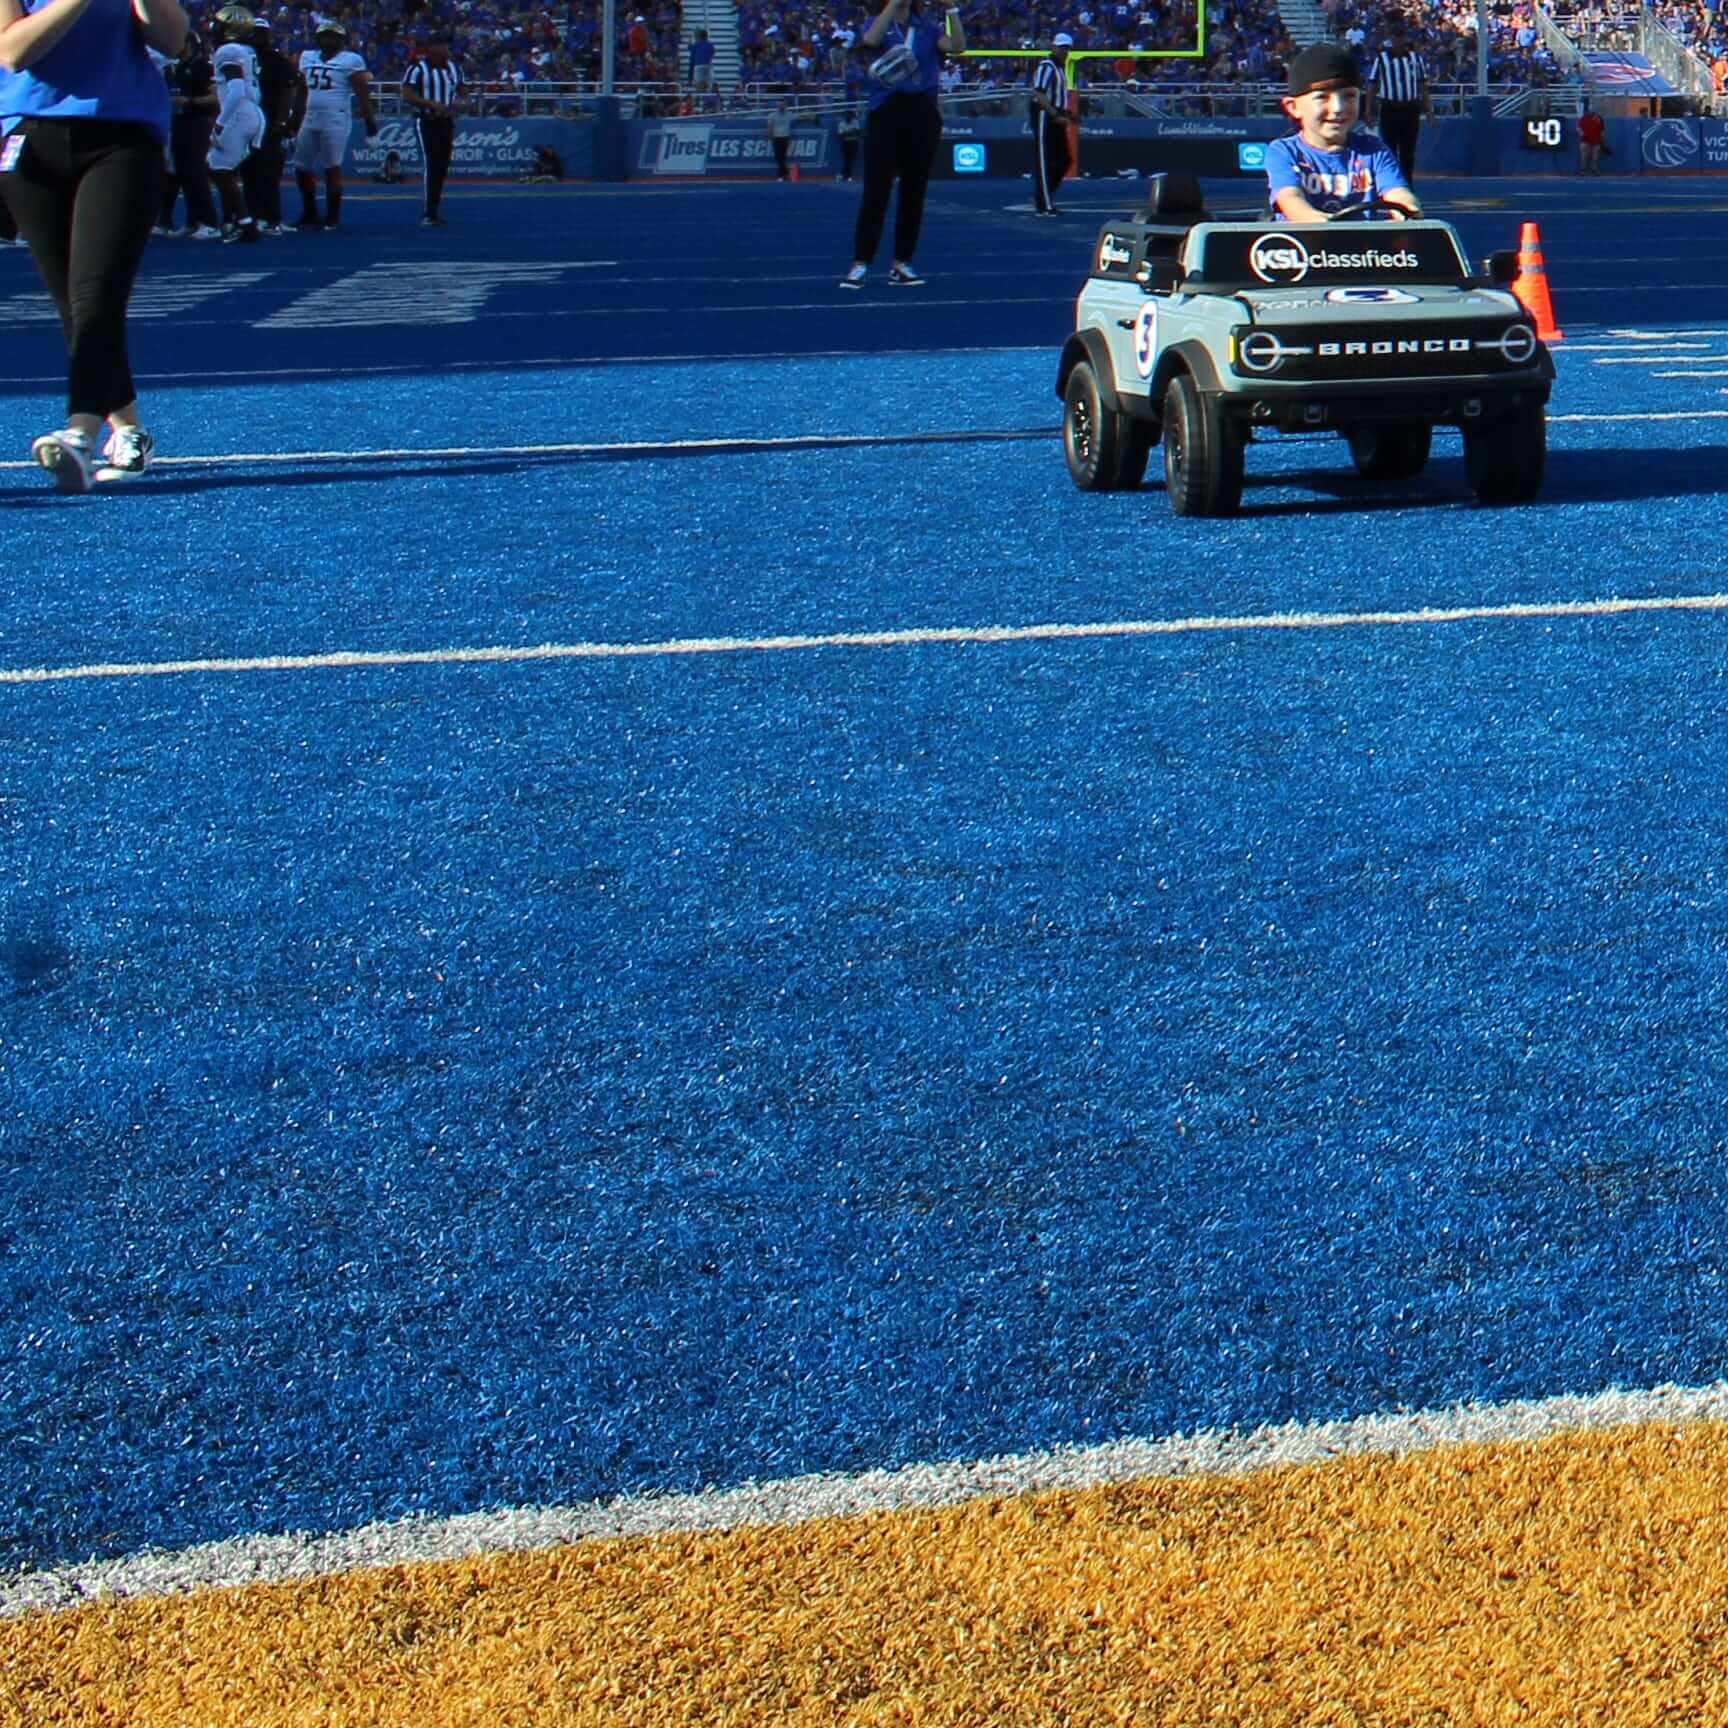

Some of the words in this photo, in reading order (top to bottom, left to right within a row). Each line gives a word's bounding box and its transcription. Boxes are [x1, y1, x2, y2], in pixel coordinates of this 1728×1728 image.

[309, 66, 332, 90] 55
[1527, 119, 1561, 146] 40
[663, 132, 706, 160] Tires
[710, 139, 740, 157] LES
[1308, 249, 1418, 269] classifieds
[1138, 317, 1152, 366] 3
[1318, 337, 1470, 356] BRONCO
